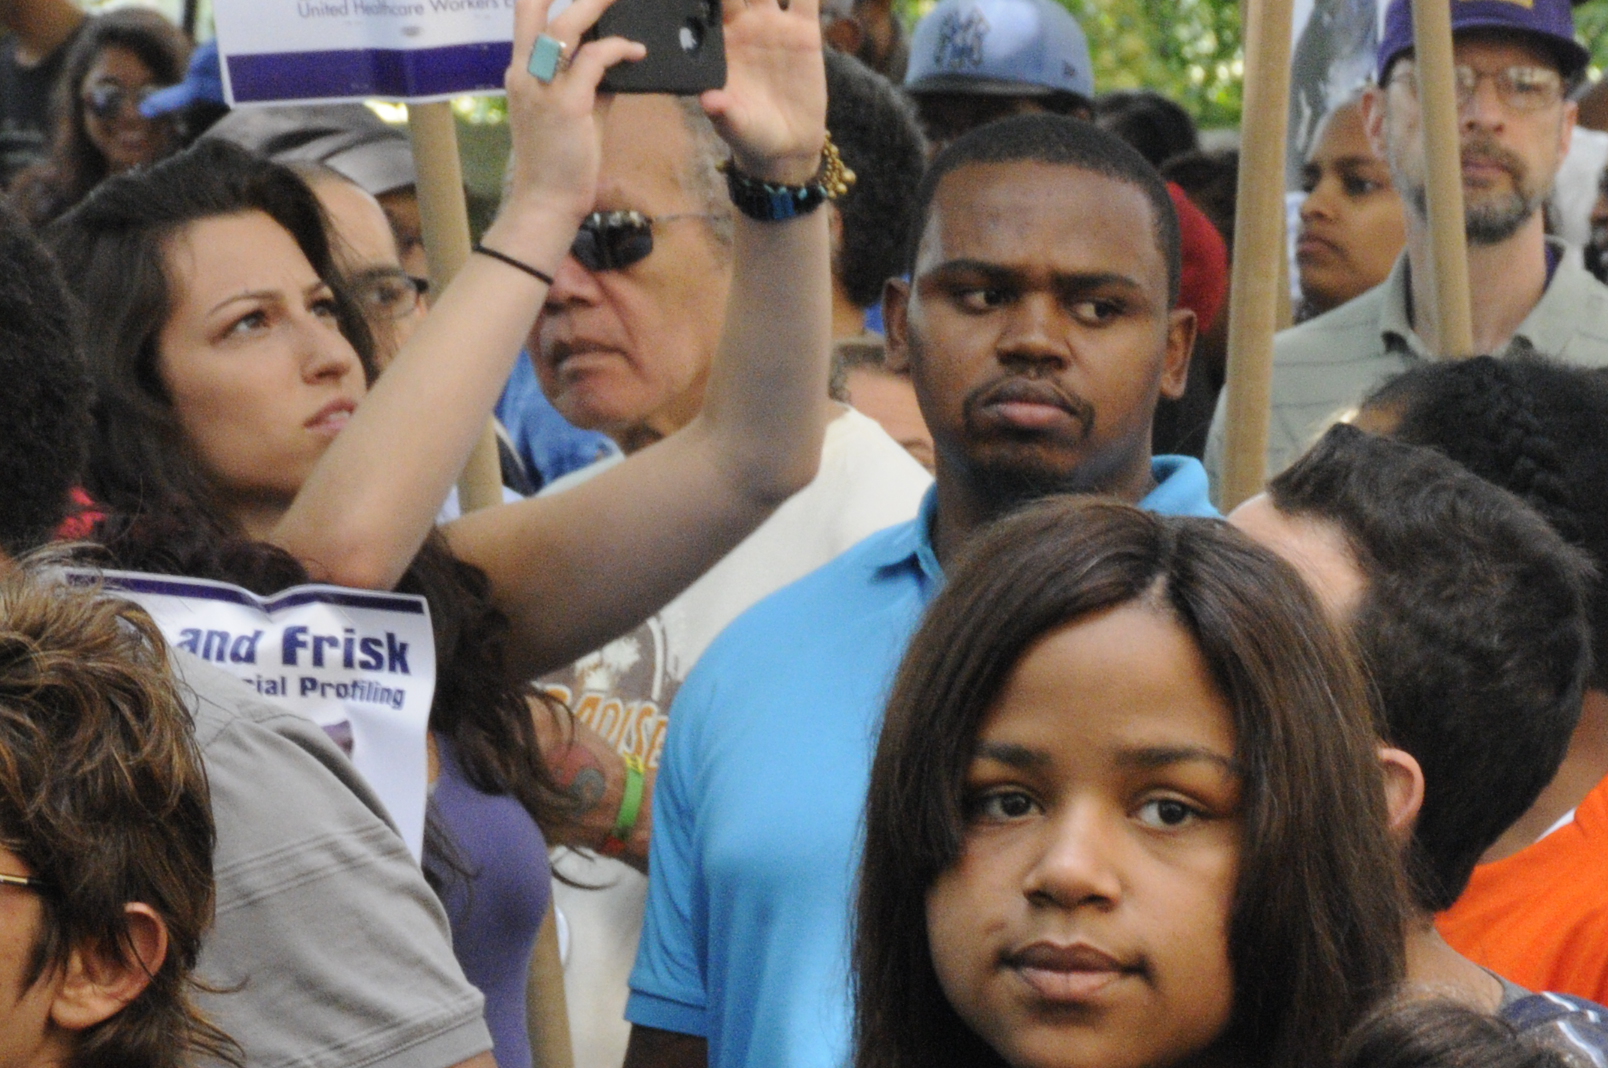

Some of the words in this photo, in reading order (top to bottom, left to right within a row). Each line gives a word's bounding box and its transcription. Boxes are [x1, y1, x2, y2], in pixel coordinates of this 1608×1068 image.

[299, 2, 348, 19] United
[353, 0, 425, 17] Healthcare
[430, 0, 498, 12] Workers
[176, 627, 264, 665] and
[281, 625, 412, 675] Frisk
[242, 676, 288, 698] ial
[299, 675, 407, 711] Profiling
